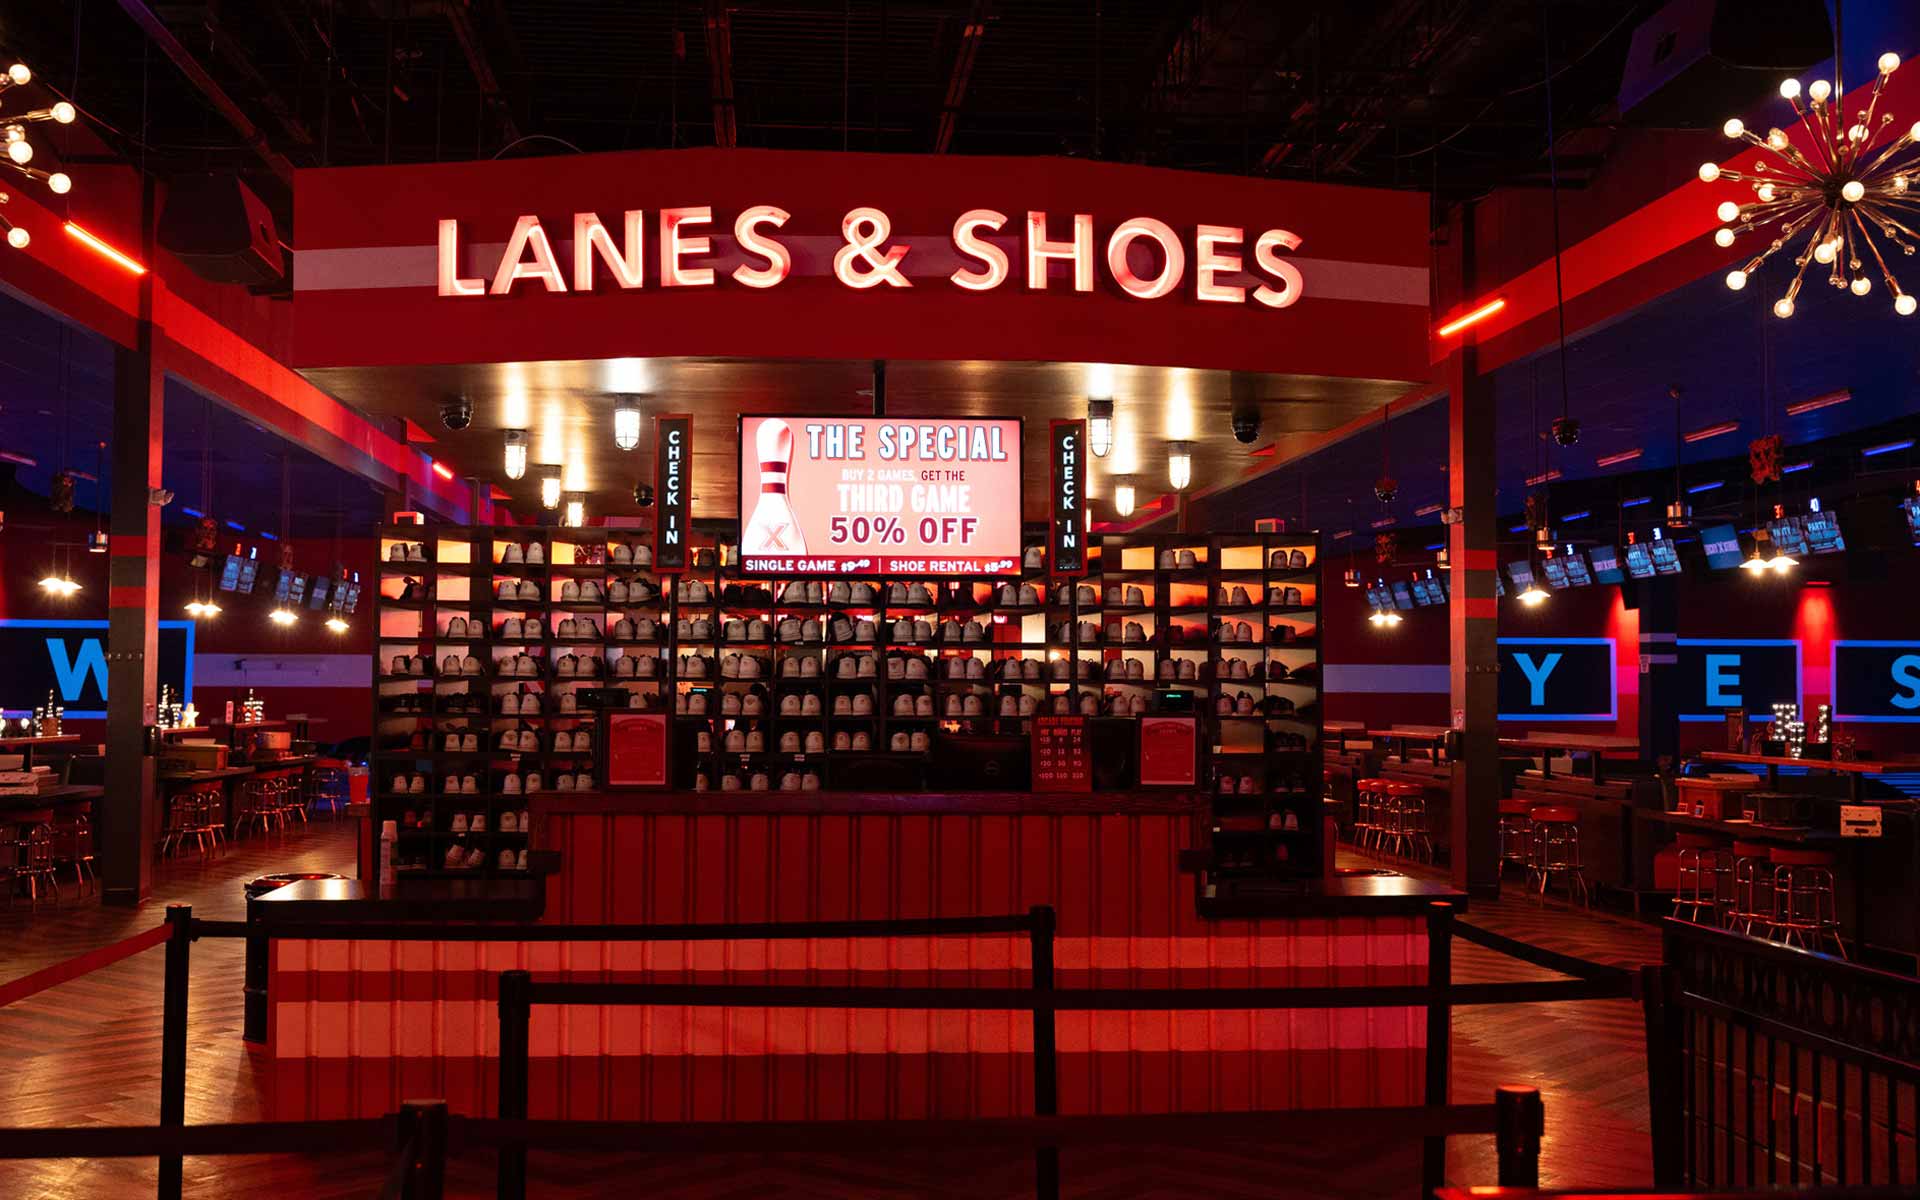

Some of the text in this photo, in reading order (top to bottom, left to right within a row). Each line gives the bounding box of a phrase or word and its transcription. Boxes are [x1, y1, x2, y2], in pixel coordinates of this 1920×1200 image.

[438, 205, 1303, 308] LANES & SHOES
[806, 424, 1008, 461] THE SPECIAL
[666, 430, 681, 506] CHECK
[842, 469, 864, 481] BUY
[867, 469, 875, 481] 2
[921, 470, 941, 481] GET
[945, 470, 965, 481] THE
[1062, 436, 1075, 510] CHECK
[837, 484, 971, 513] THIRD GAME
[666, 515, 679, 545] IN
[831, 516, 979, 544] 50% OFF
[1063, 519, 1076, 548] IN
[745, 559, 795, 571] SINGLE
[797, 559, 836, 571] GAME
[889, 560, 926, 572] SHOE
[929, 560, 981, 572] RENTAL
[1512, 653, 1563, 706] Y
[1705, 654, 1743, 706] E
